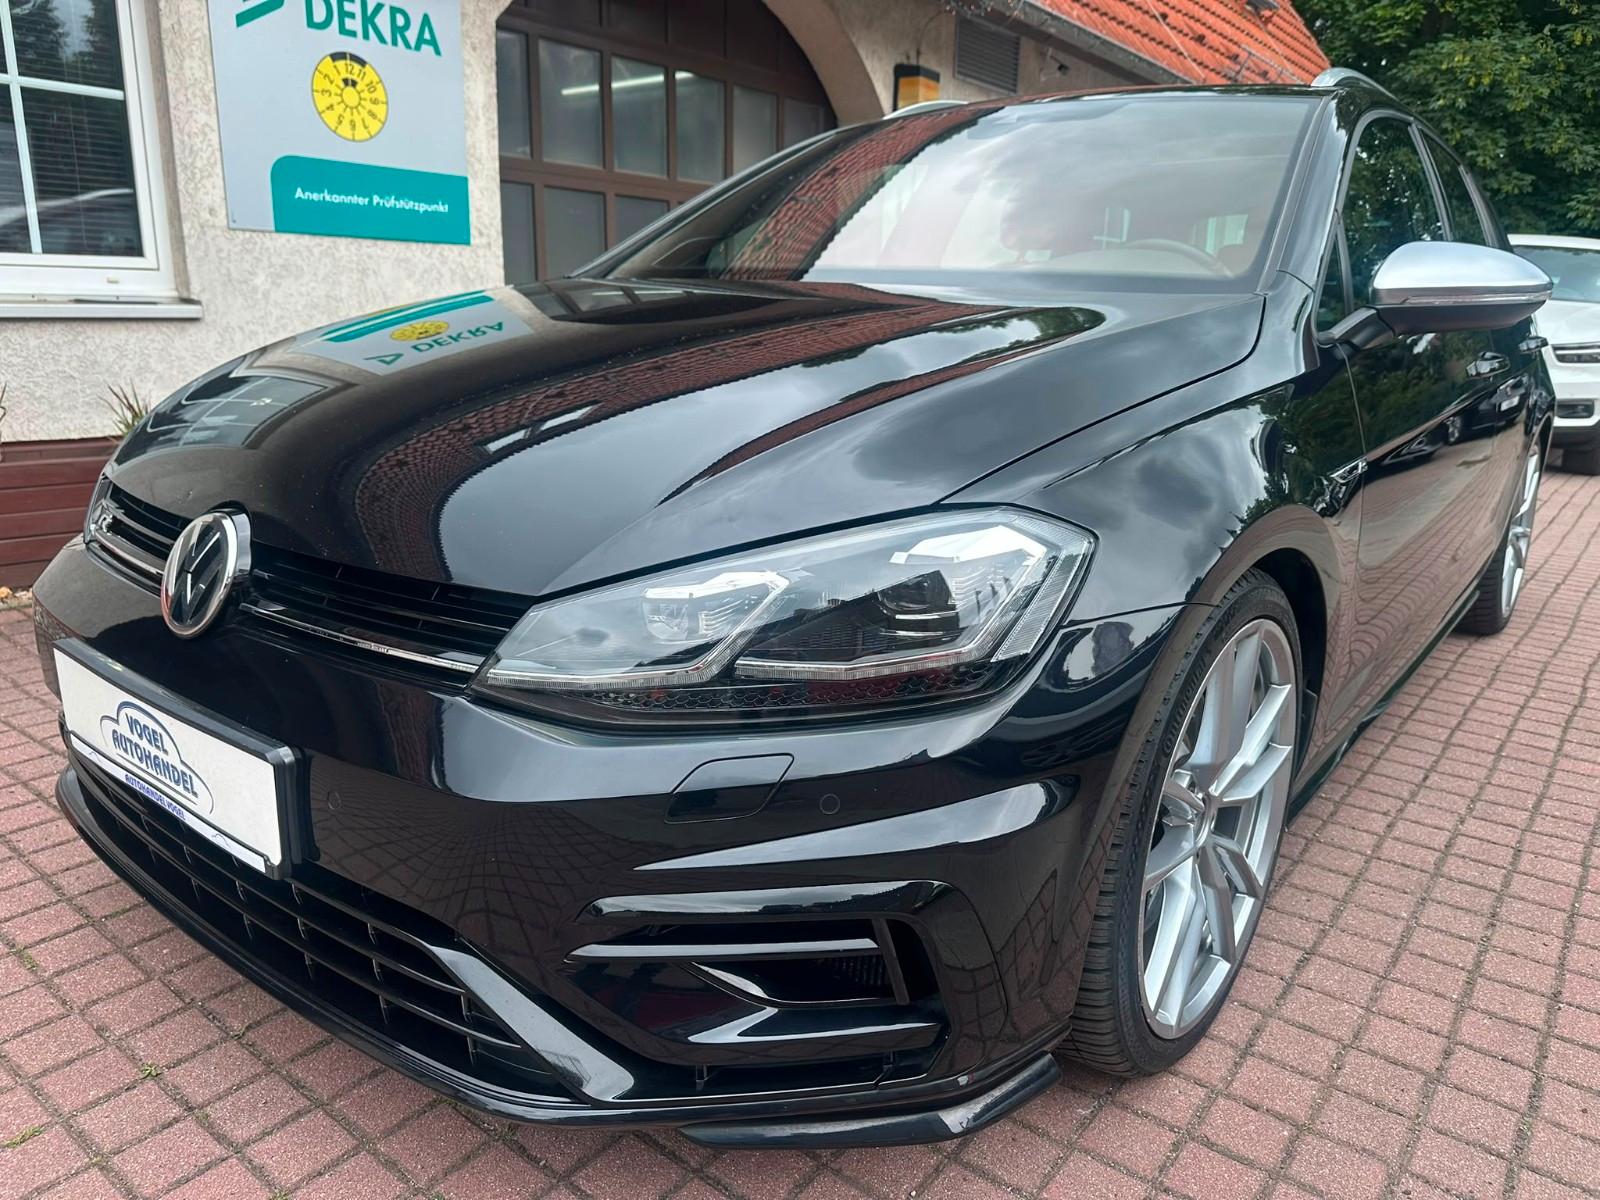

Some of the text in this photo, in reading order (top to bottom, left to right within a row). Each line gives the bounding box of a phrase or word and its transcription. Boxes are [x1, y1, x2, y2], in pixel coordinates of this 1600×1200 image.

[304, 0, 441, 57] DEKRA
[333, 64, 340, 76] 1
[345, 62, 355, 76] 12
[357, 69, 366, 81] 11
[323, 73, 335, 85] 2
[320, 88, 332, 98] 3
[366, 80, 377, 94] 10
[295, 187, 448, 213] Anerkannter Prüfstützpunkt
[125, 712, 169, 756] VOGEL
[112, 729, 199, 798] AUTOHANDEL
